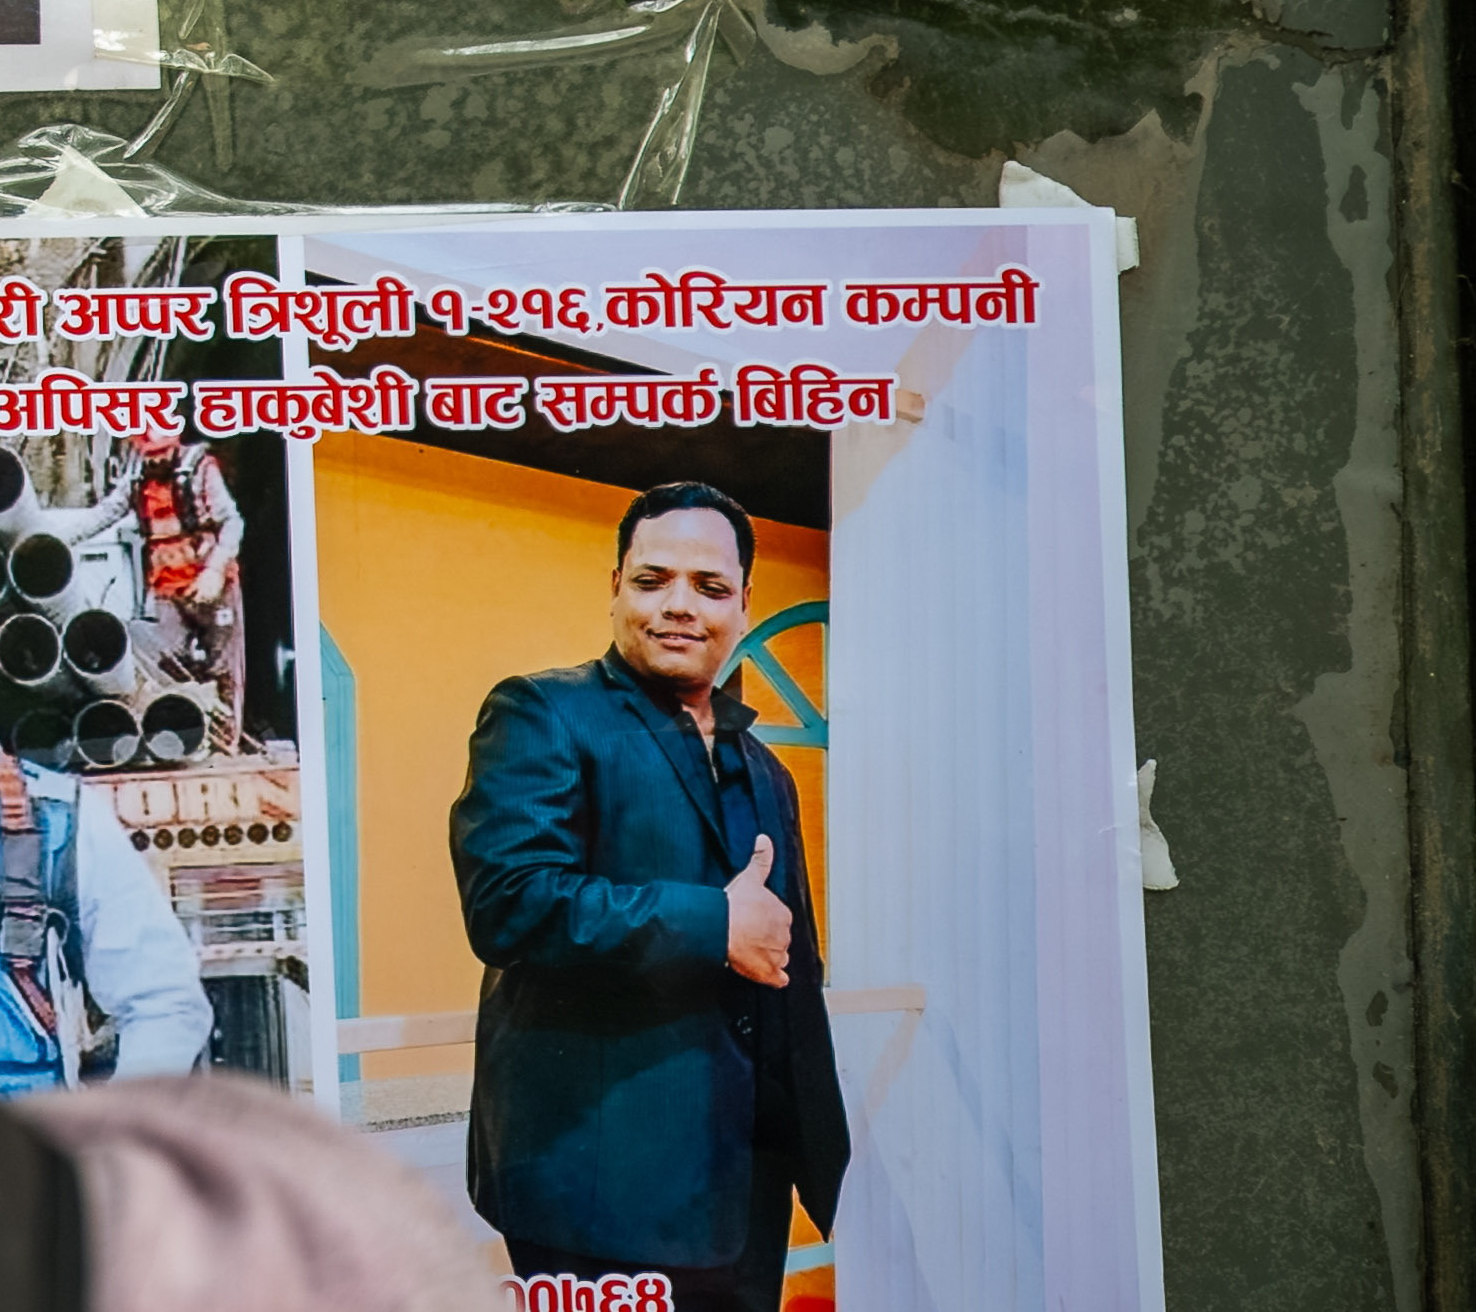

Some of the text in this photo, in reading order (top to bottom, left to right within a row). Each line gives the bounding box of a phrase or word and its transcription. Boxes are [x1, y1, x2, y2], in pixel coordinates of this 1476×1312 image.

[61, 292, 211, 337] अप्पर
[229, 277, 415, 347] त्रिशूली
[846, 269, 1040, 325] कम्पनी
[199, 370, 413, 439] हाकुबेशी
[431, 378, 525, 424] बाट
[542, 370, 718, 427] सम्पर्क
[737, 364, 894, 421] बिहिन
